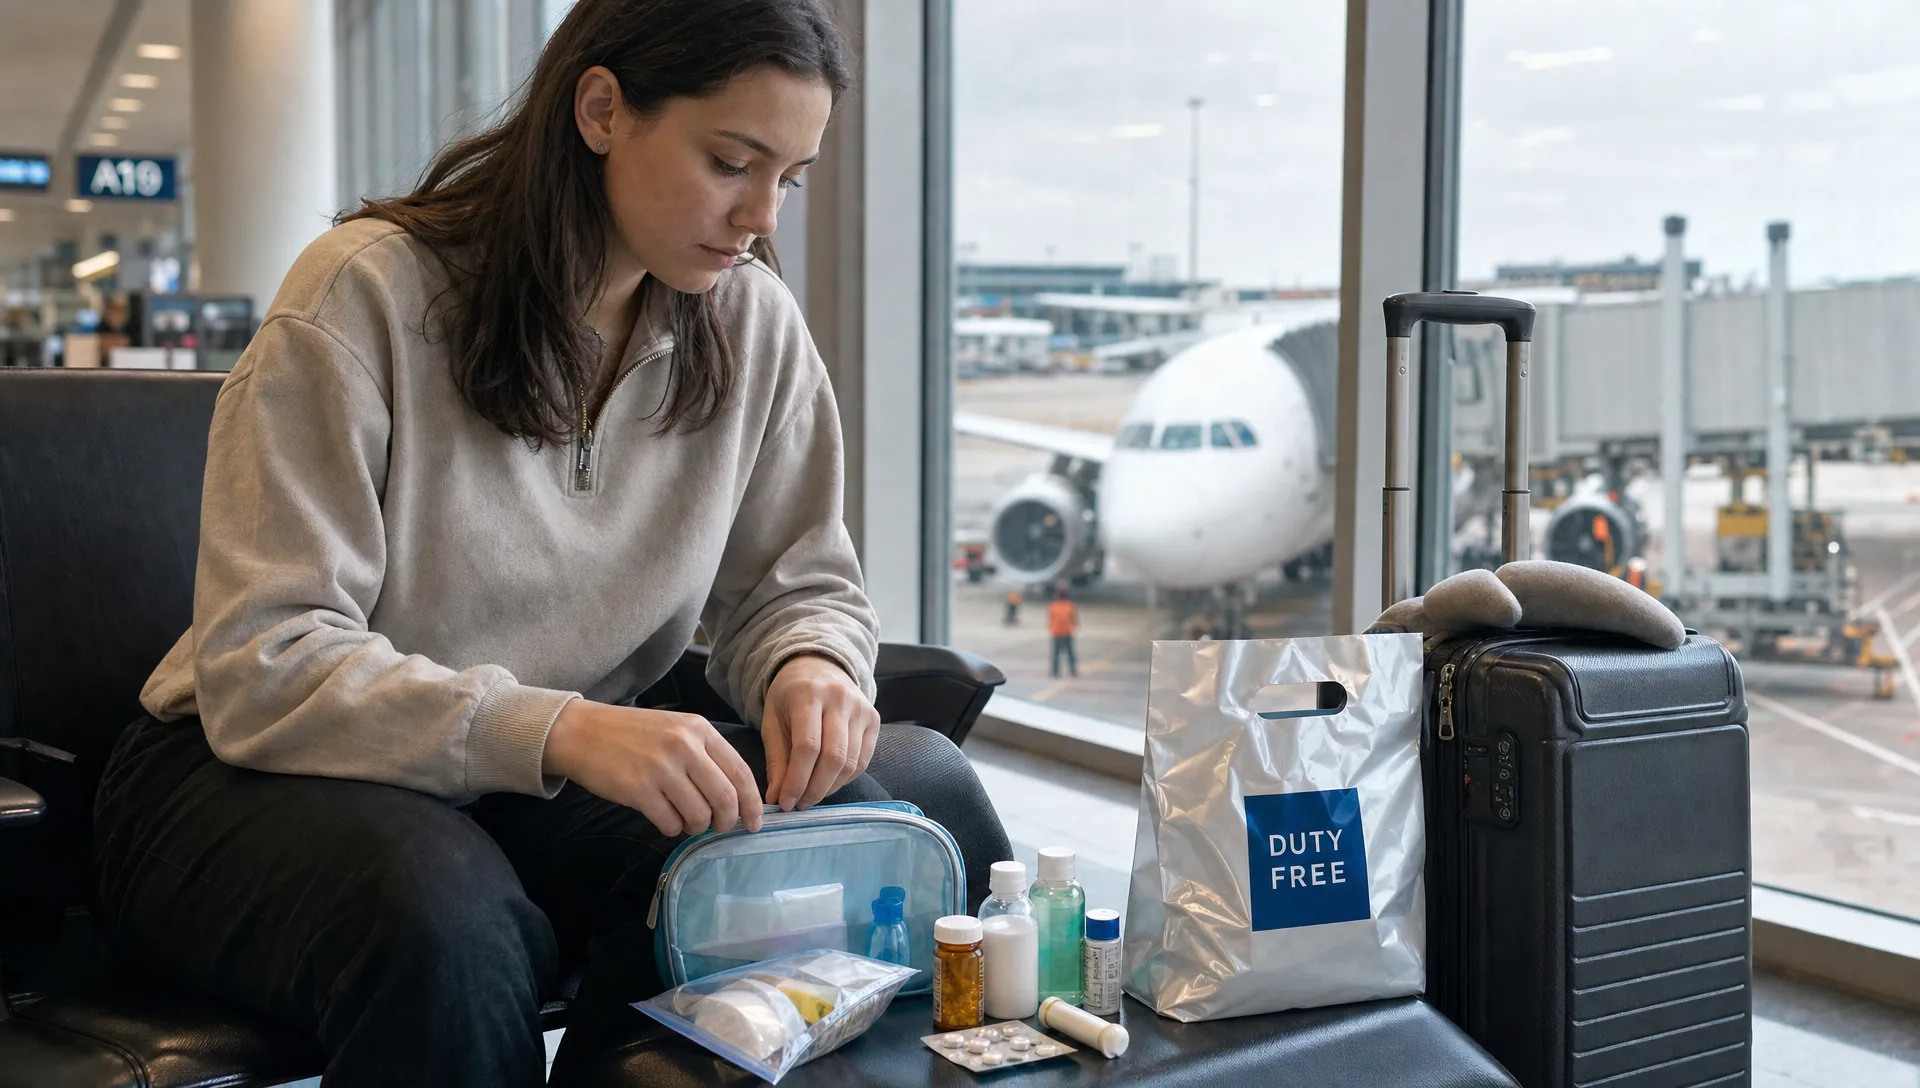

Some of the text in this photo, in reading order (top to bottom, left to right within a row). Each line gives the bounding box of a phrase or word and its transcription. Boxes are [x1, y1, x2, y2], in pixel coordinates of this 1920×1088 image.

[90, 159, 163, 197] A19
[1268, 829, 1343, 857] DUTY
[1271, 861, 1346, 890] FREE
